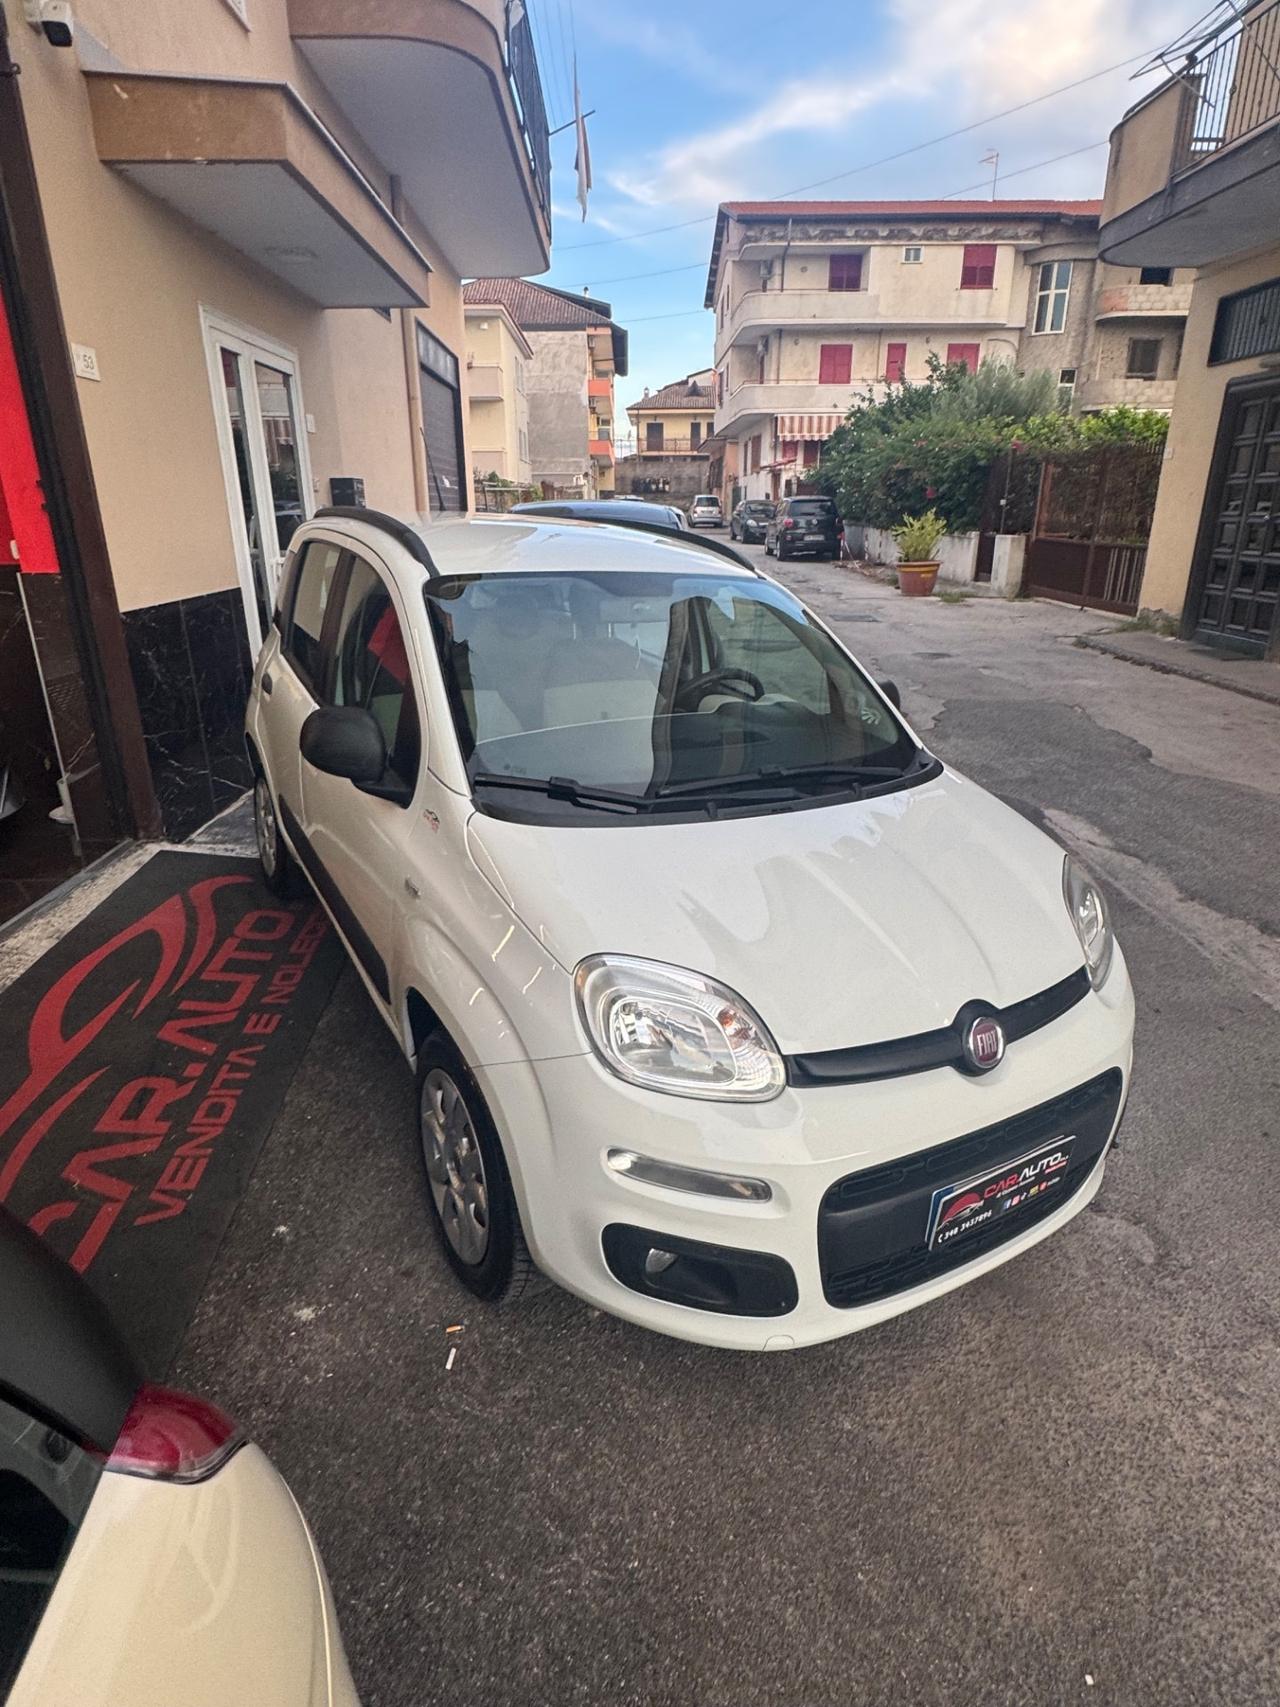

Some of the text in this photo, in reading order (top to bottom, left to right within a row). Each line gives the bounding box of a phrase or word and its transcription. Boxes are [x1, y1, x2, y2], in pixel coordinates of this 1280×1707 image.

[83, 354, 94, 369] 53
[976, 1031, 998, 1056] FIAT
[134, 1044, 269, 1226] VENDITA
[245, 1013, 282, 1037] E
